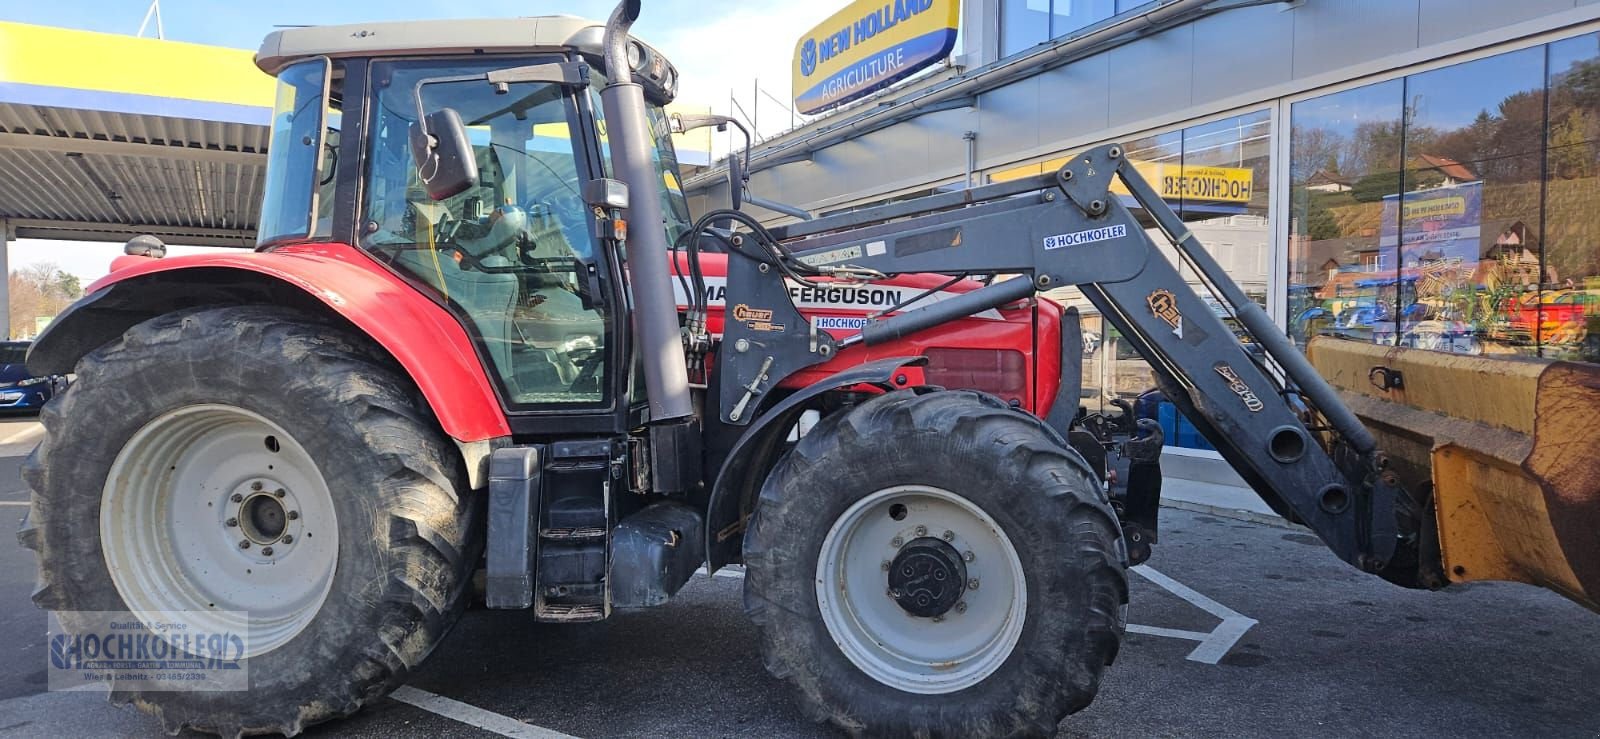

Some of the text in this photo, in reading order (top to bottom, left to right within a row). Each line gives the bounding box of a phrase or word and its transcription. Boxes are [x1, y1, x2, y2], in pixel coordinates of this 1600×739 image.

[819, 0, 932, 63] NEW HOLLAND
[822, 48, 904, 101] AGRICULTURE
[1058, 225, 1124, 246] HOCHKOFLER
[790, 287, 902, 305] FERGUSON
[822, 318, 867, 328] HOCHKOF
